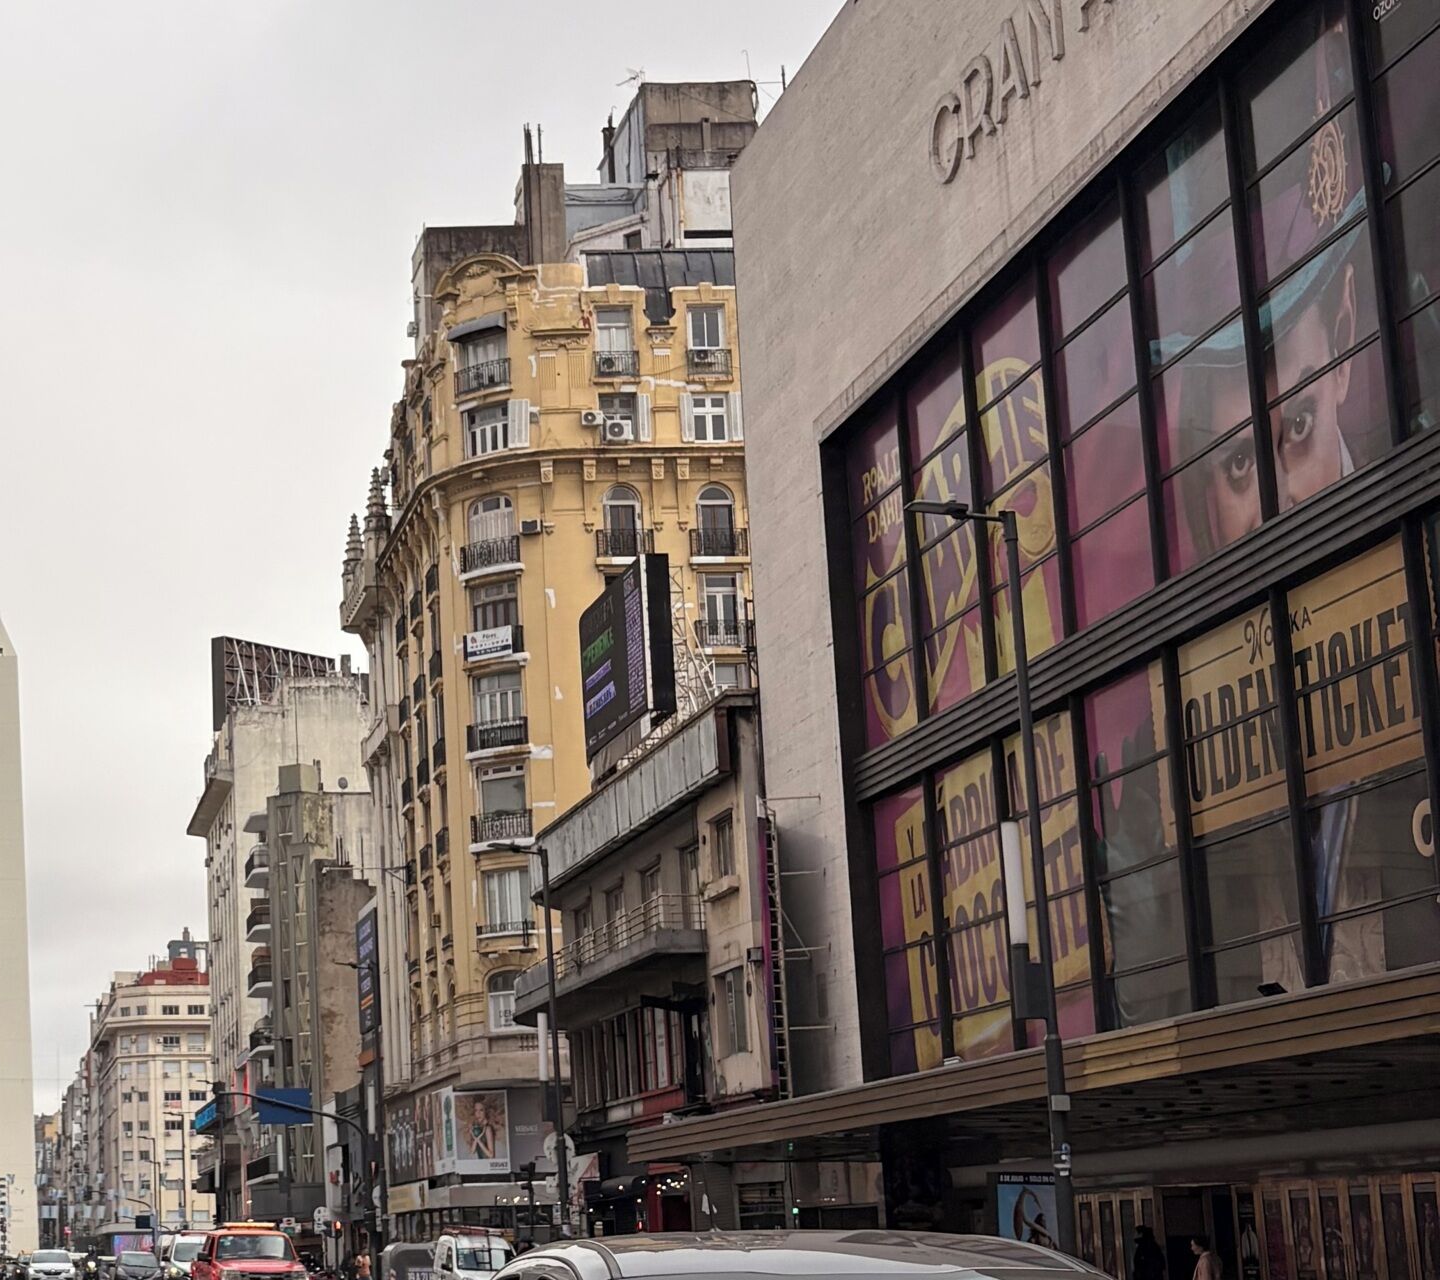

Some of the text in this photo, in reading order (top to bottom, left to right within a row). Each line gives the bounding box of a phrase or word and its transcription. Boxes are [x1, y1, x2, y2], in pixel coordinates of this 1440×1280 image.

[1243, 605, 1312, 666] WOKA
[1184, 661, 1287, 804] OLDEN
[910, 872, 927, 920] LA
